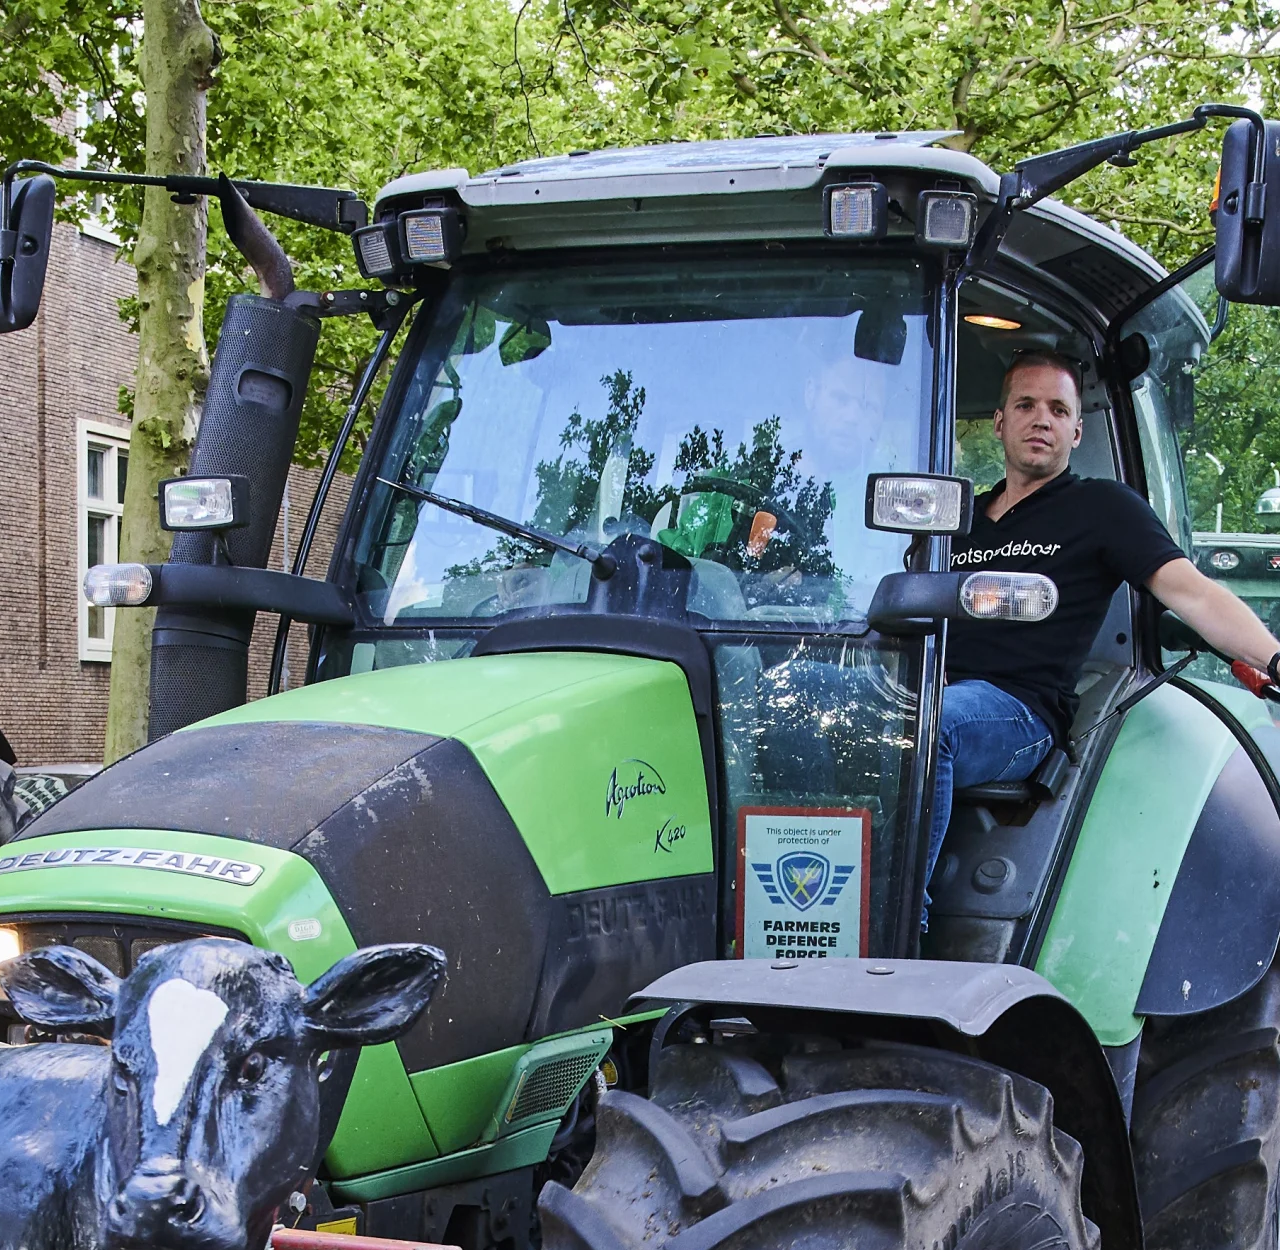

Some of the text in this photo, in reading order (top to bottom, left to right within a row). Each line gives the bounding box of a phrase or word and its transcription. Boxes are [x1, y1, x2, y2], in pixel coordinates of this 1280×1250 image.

[766, 827, 842, 838] This object is under
[777, 837, 819, 845] protection
[763, 920, 841, 933] FARMERS
[766, 935, 837, 948] DEFENCE
